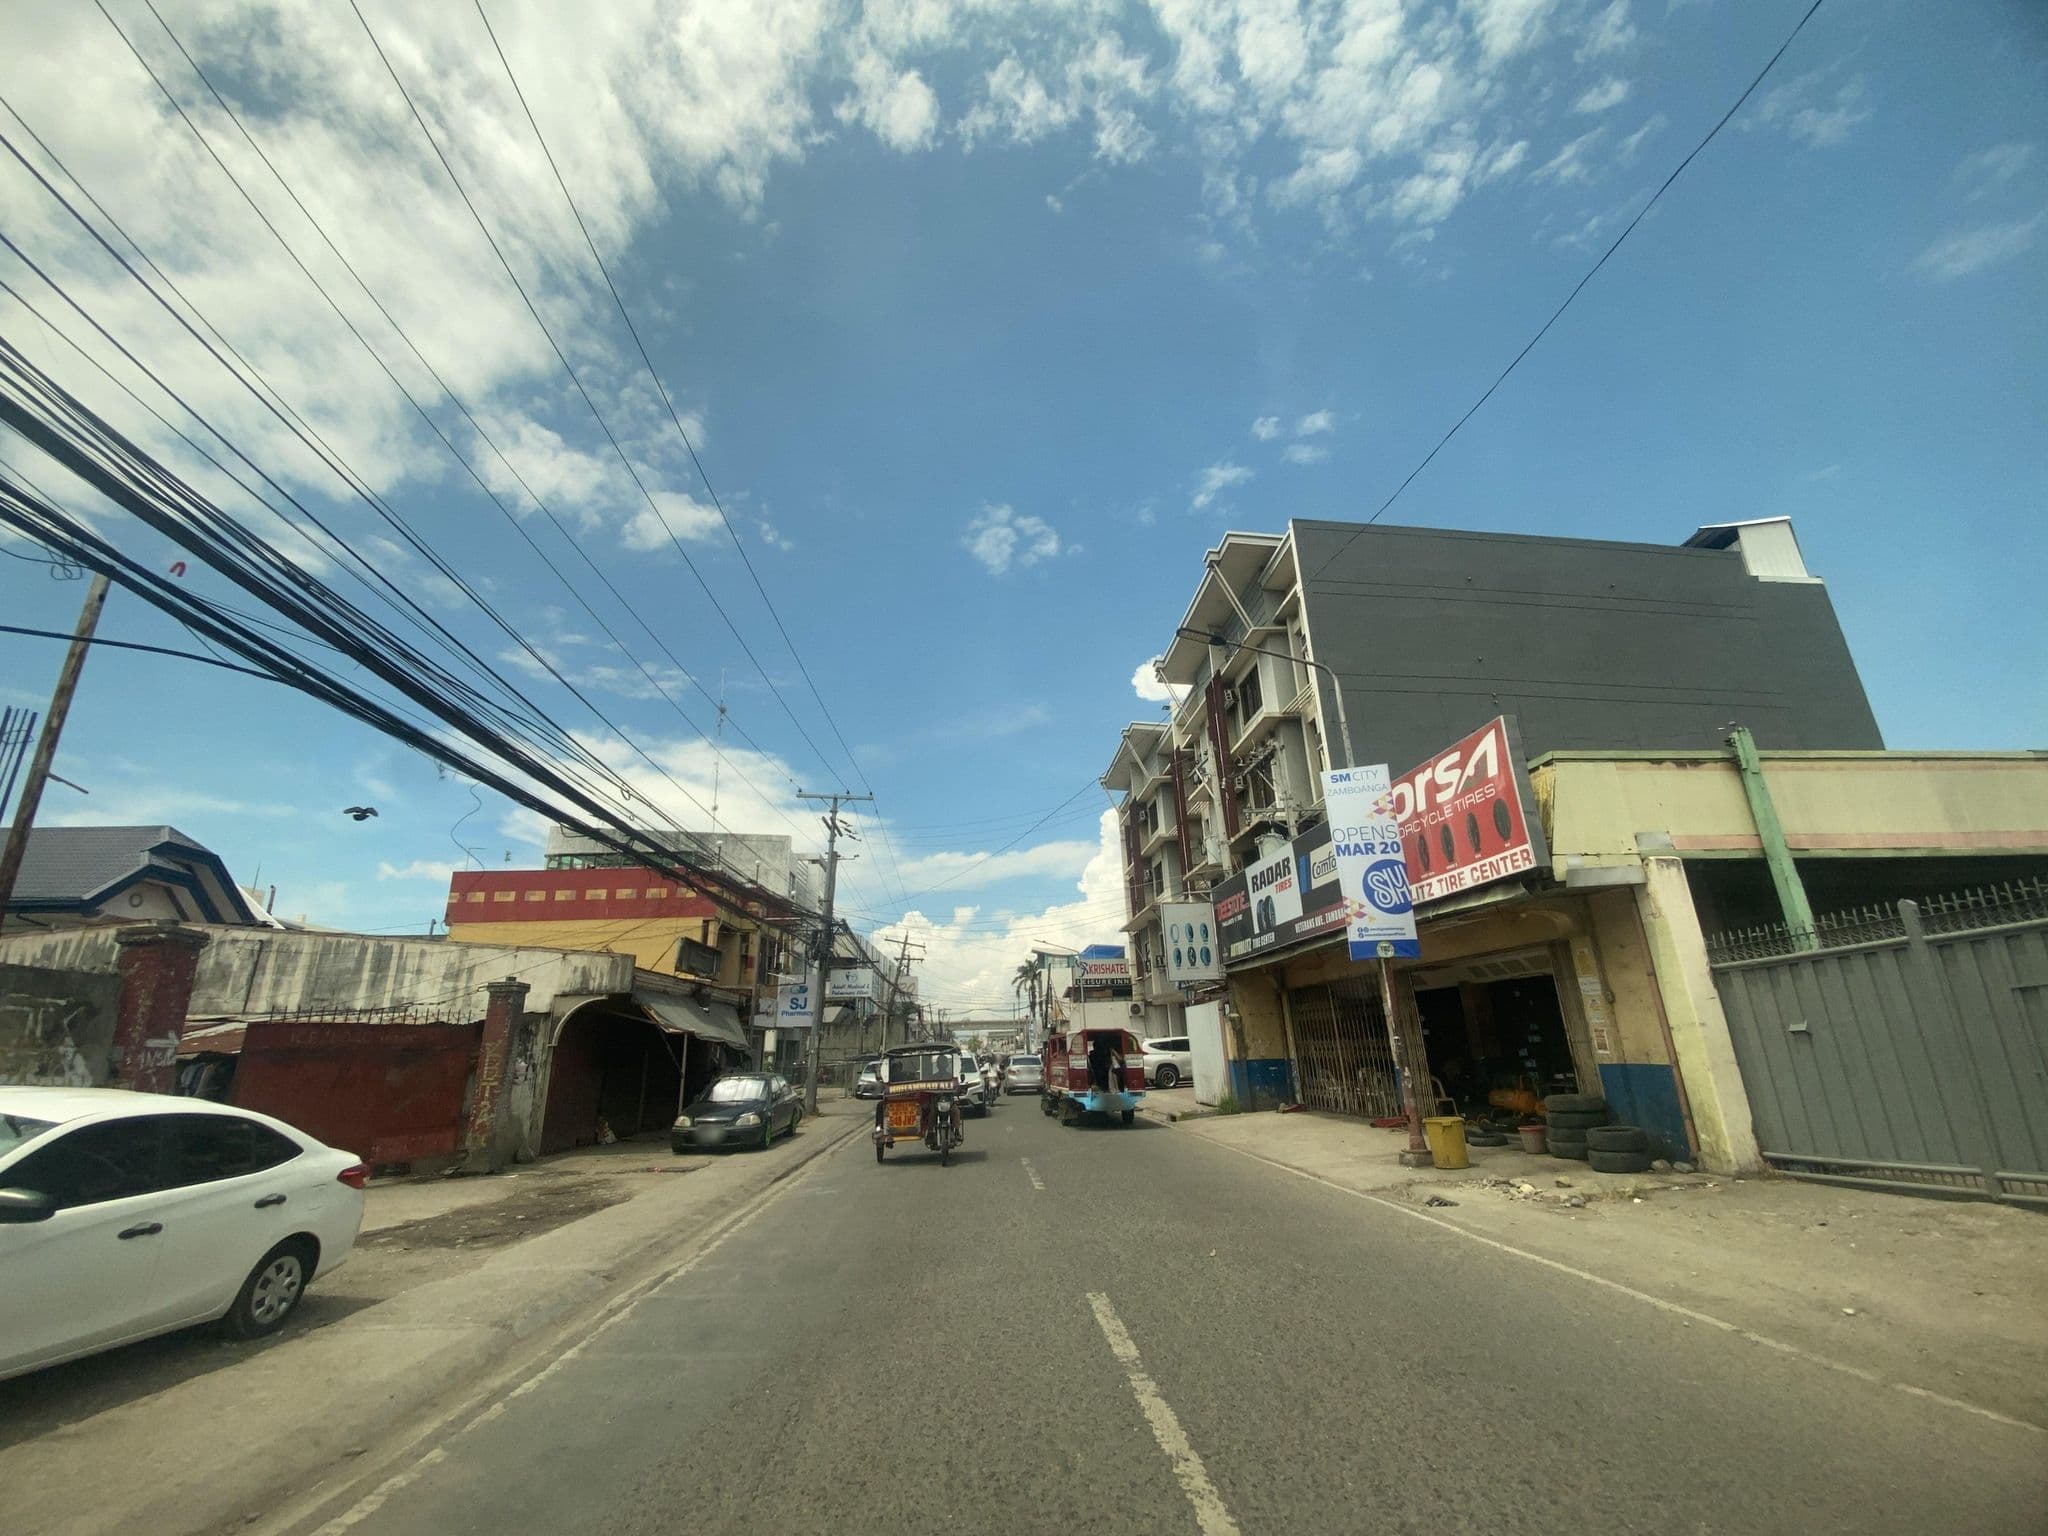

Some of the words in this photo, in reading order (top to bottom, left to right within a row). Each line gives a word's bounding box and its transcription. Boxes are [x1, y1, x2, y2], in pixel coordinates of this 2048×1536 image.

[1331, 773, 1350, 784] SM
[1352, 769, 1378, 781] CITY
[1327, 783, 1388, 797] ZAMBOANGA
[1455, 783, 1496, 811] TIRES
[1332, 824, 1398, 843] OPENS
[1335, 842, 1376, 857] MAR
[1380, 841, 1401, 854] 20
[1252, 858, 1291, 893] RADAR
[1437, 871, 1467, 894] TIRE
[1471, 849, 1532, 883] CENTER
[1275, 878, 1292, 894] TIRES
[1088, 963, 1129, 974] KRISHATEL
[789, 997, 808, 1010] SJ
